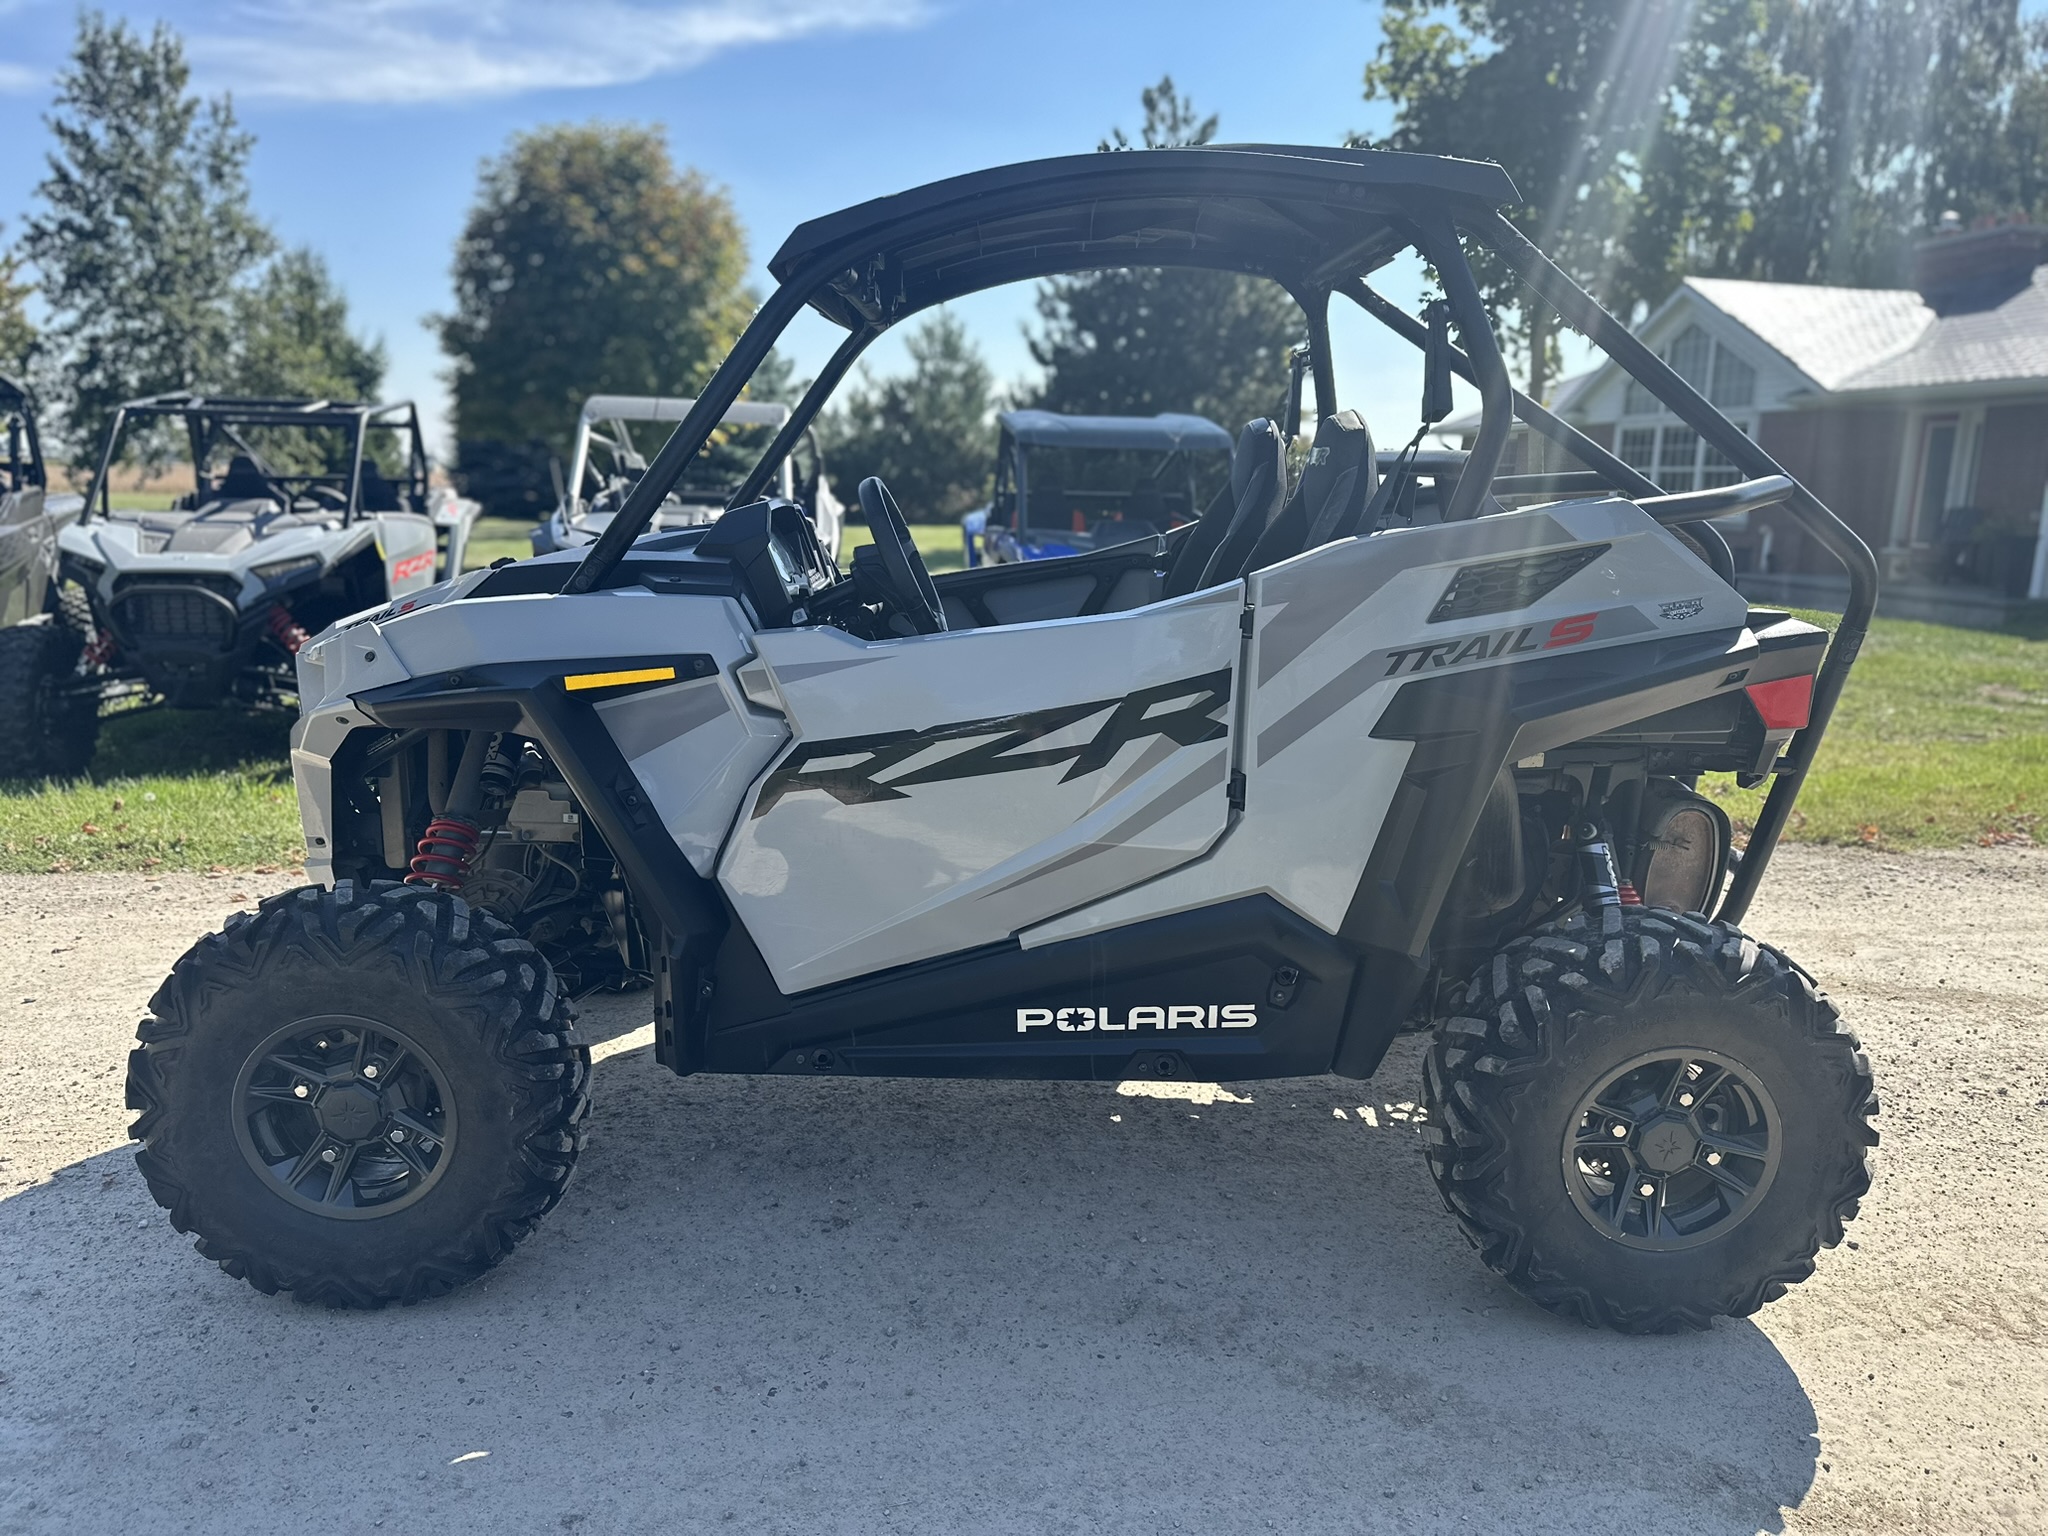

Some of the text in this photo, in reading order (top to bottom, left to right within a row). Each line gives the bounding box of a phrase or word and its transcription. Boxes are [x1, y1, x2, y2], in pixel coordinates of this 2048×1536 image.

[1384, 611, 1600, 677] TRAIL S
[750, 667, 1233, 820] RZR
[1016, 1003, 1258, 1033] POLARIS
